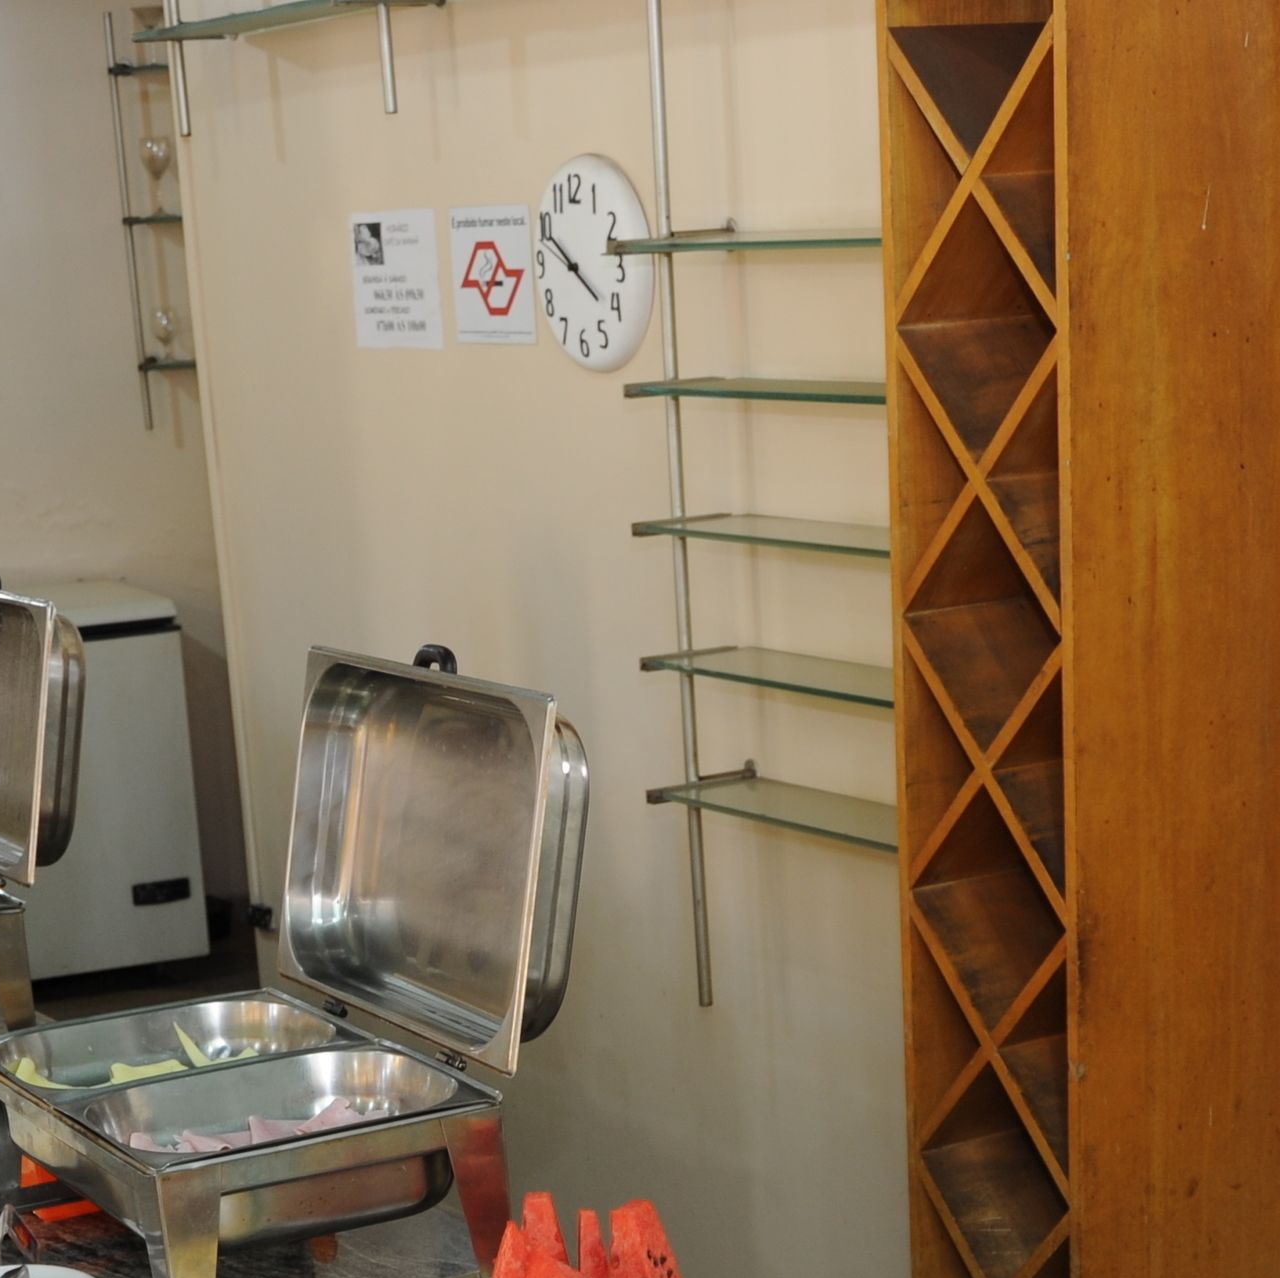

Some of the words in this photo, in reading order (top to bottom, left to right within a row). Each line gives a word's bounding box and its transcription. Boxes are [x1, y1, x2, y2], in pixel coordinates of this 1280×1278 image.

[552, 183, 563, 214] 11
[567, 173, 581, 204] 12
[591, 183, 597, 215] 1
[539, 211, 553, 242] 10
[606, 211, 618, 241] 2
[536, 250, 545, 279] 9
[616, 255, 626, 283] 3
[545, 288, 555, 318] 8
[610, 292, 622, 323] 4
[559, 317, 568, 347] 7
[579, 329, 590, 358] 6
[597, 320, 609, 350] 5
